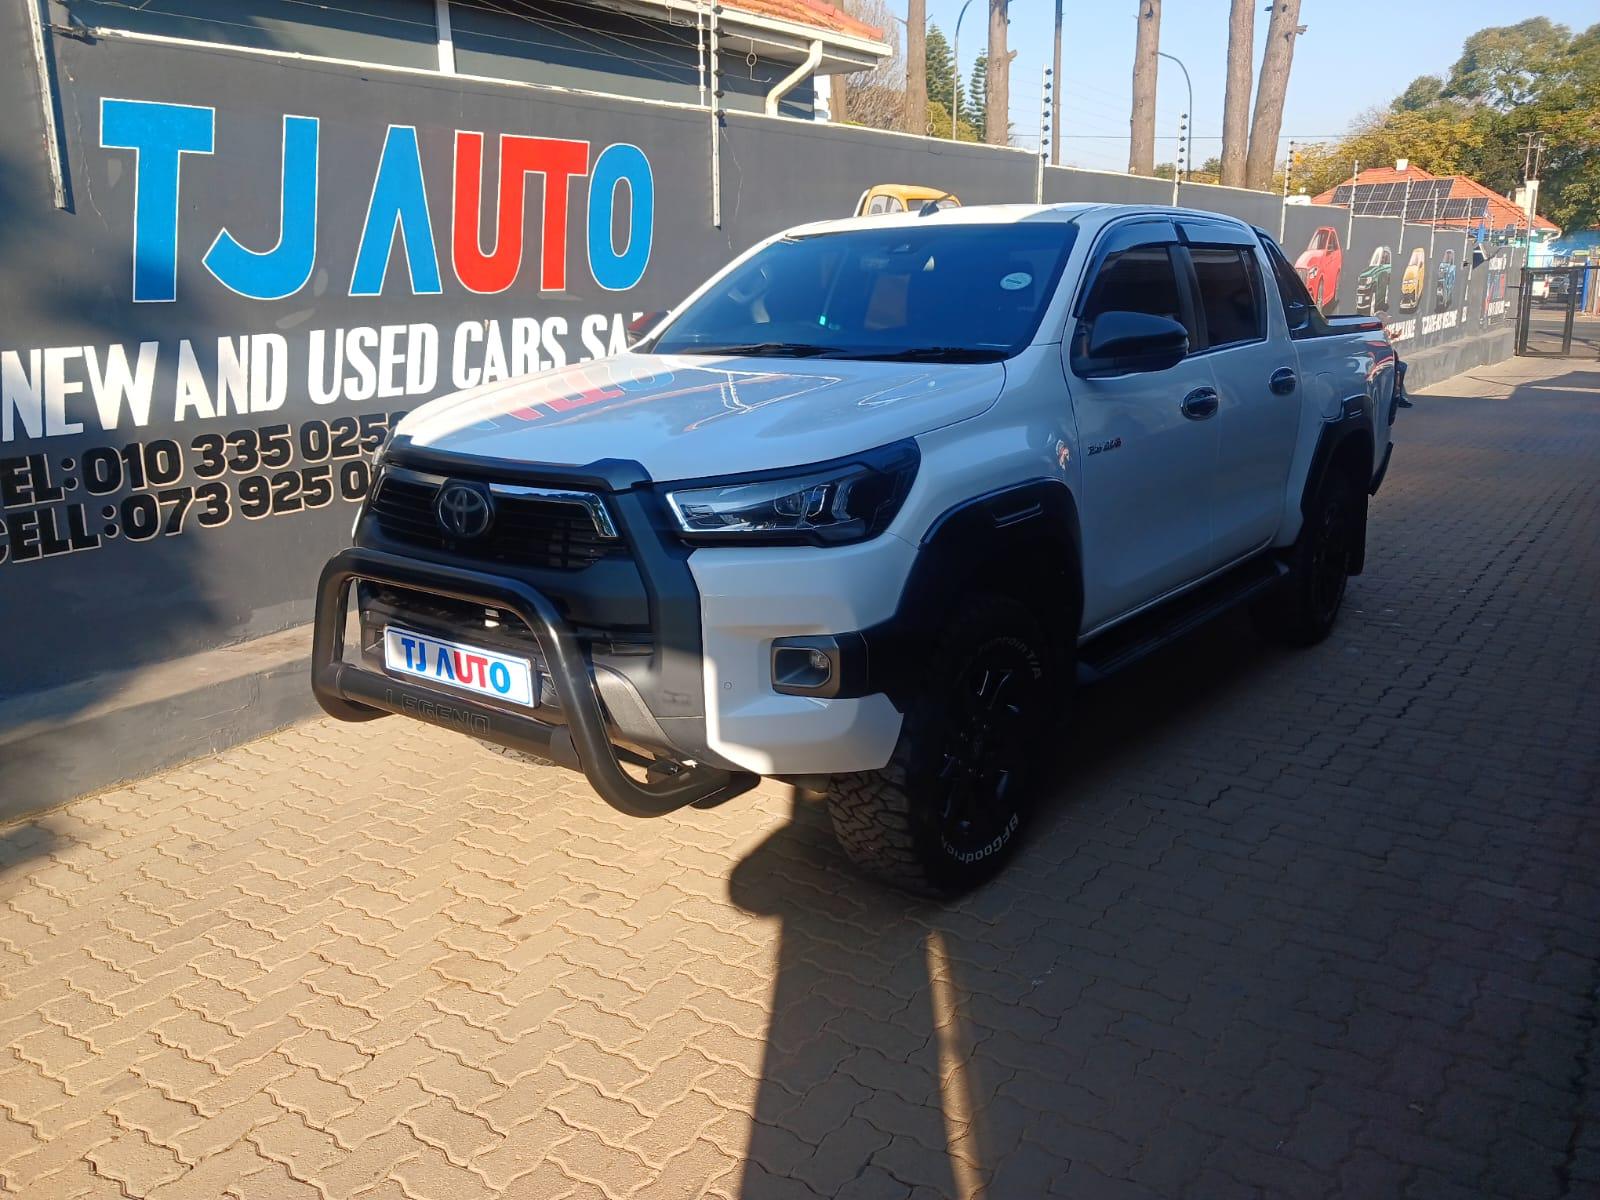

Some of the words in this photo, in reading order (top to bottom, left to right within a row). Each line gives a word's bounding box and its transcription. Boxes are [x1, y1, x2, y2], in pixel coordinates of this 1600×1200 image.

[100, 97, 319, 303] TJ
[348, 124, 655, 297] AUTO
[1, 340, 160, 442] NEW
[174, 333, 288, 423] AND
[308, 321, 439, 404] USED
[452, 316, 568, 390] CARS
[191, 423, 293, 480] 335
[238, 464, 333, 520] 925
[401, 638, 427, 672] TJ
[436, 647, 511, 694] AUTO
[385, 688, 490, 735] LEGEND
